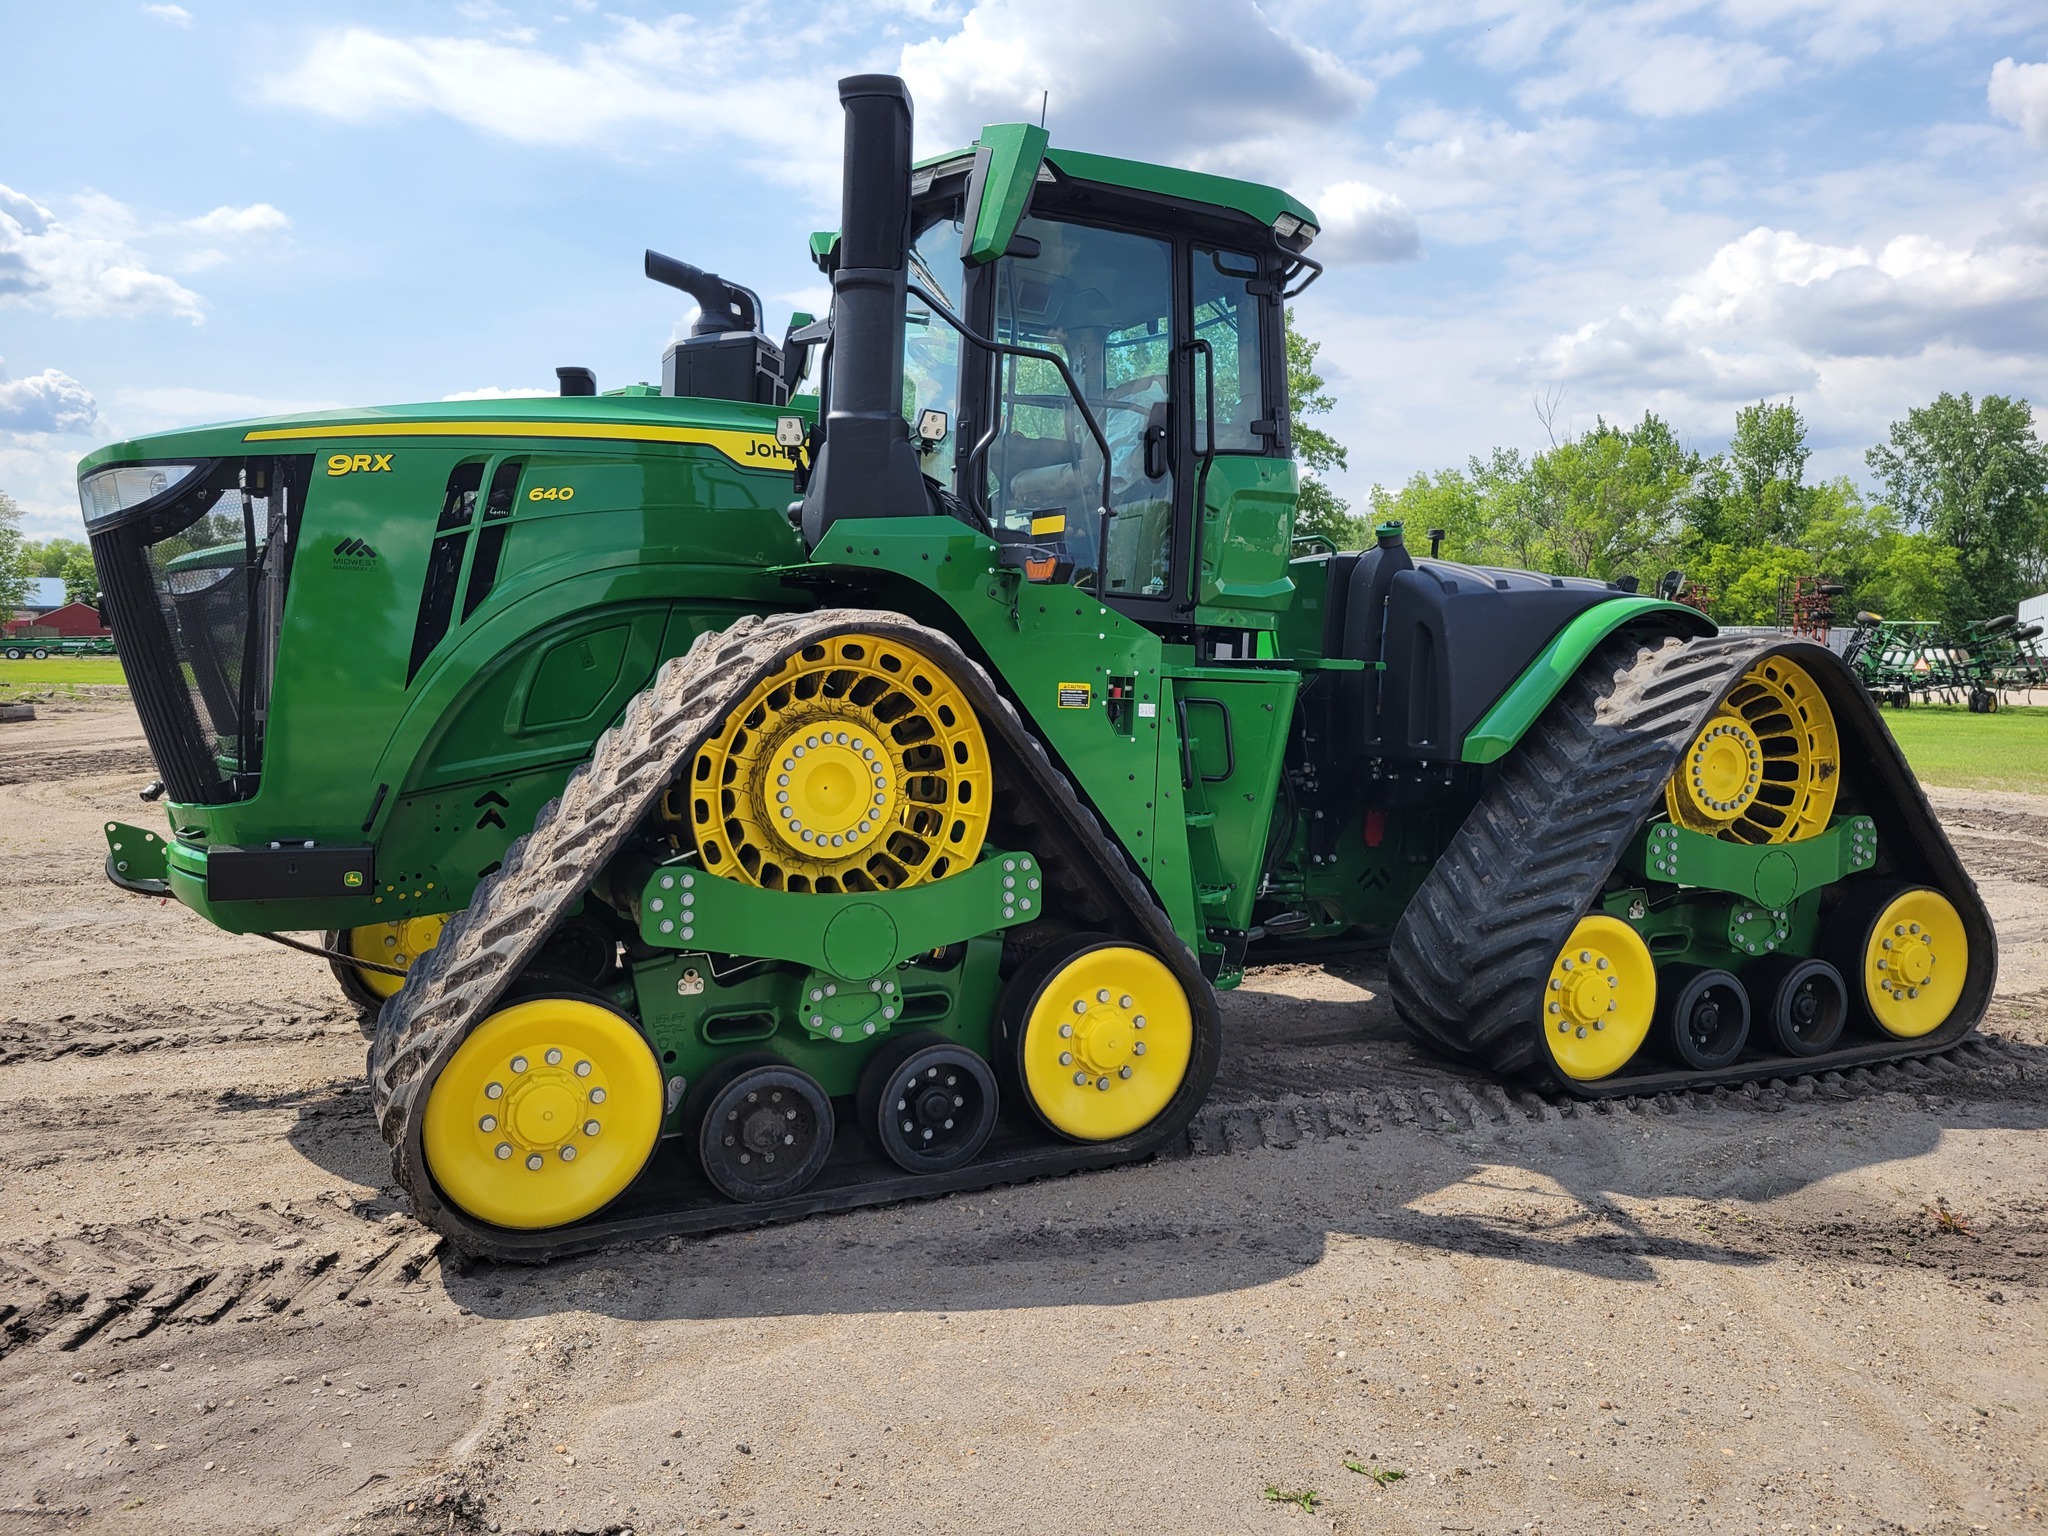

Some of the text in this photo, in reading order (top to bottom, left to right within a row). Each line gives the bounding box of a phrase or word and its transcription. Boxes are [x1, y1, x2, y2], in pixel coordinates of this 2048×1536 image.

[745, 439, 793, 461] JOH
[327, 454, 395, 476] 9RX
[528, 487, 575, 501] 640
[333, 558, 378, 566] MIDWEST
